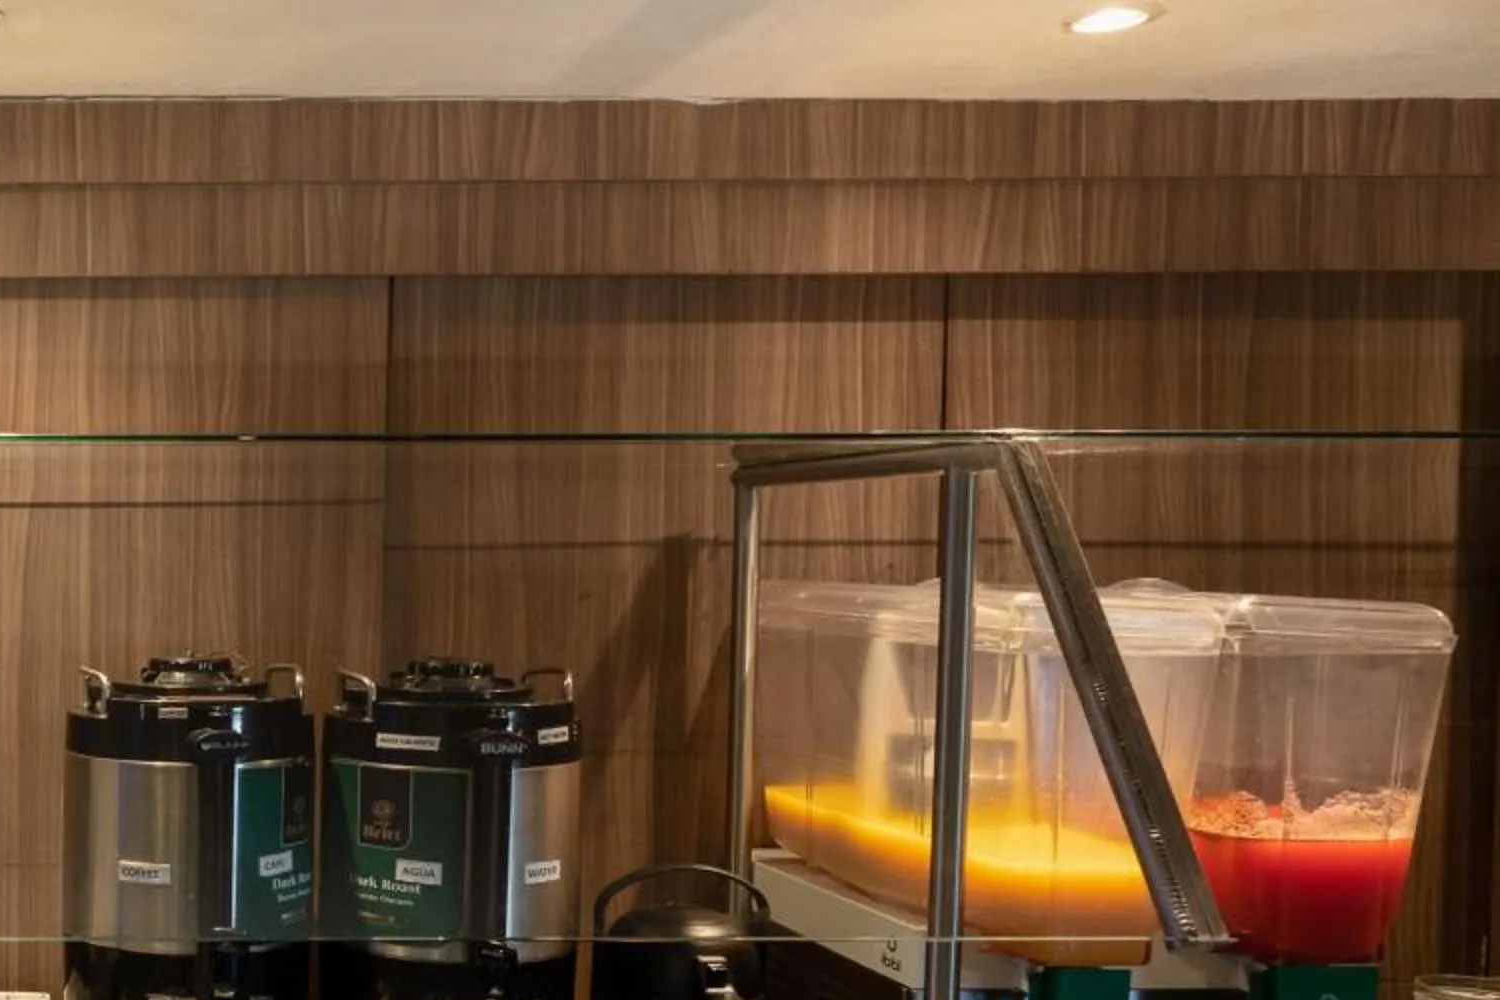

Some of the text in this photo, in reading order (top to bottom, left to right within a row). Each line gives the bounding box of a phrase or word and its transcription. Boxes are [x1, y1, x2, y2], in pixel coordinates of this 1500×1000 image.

[480, 742, 523, 755] BUNN
[121, 866, 160, 879] COFFEE
[401, 866, 436, 879] AGUA
